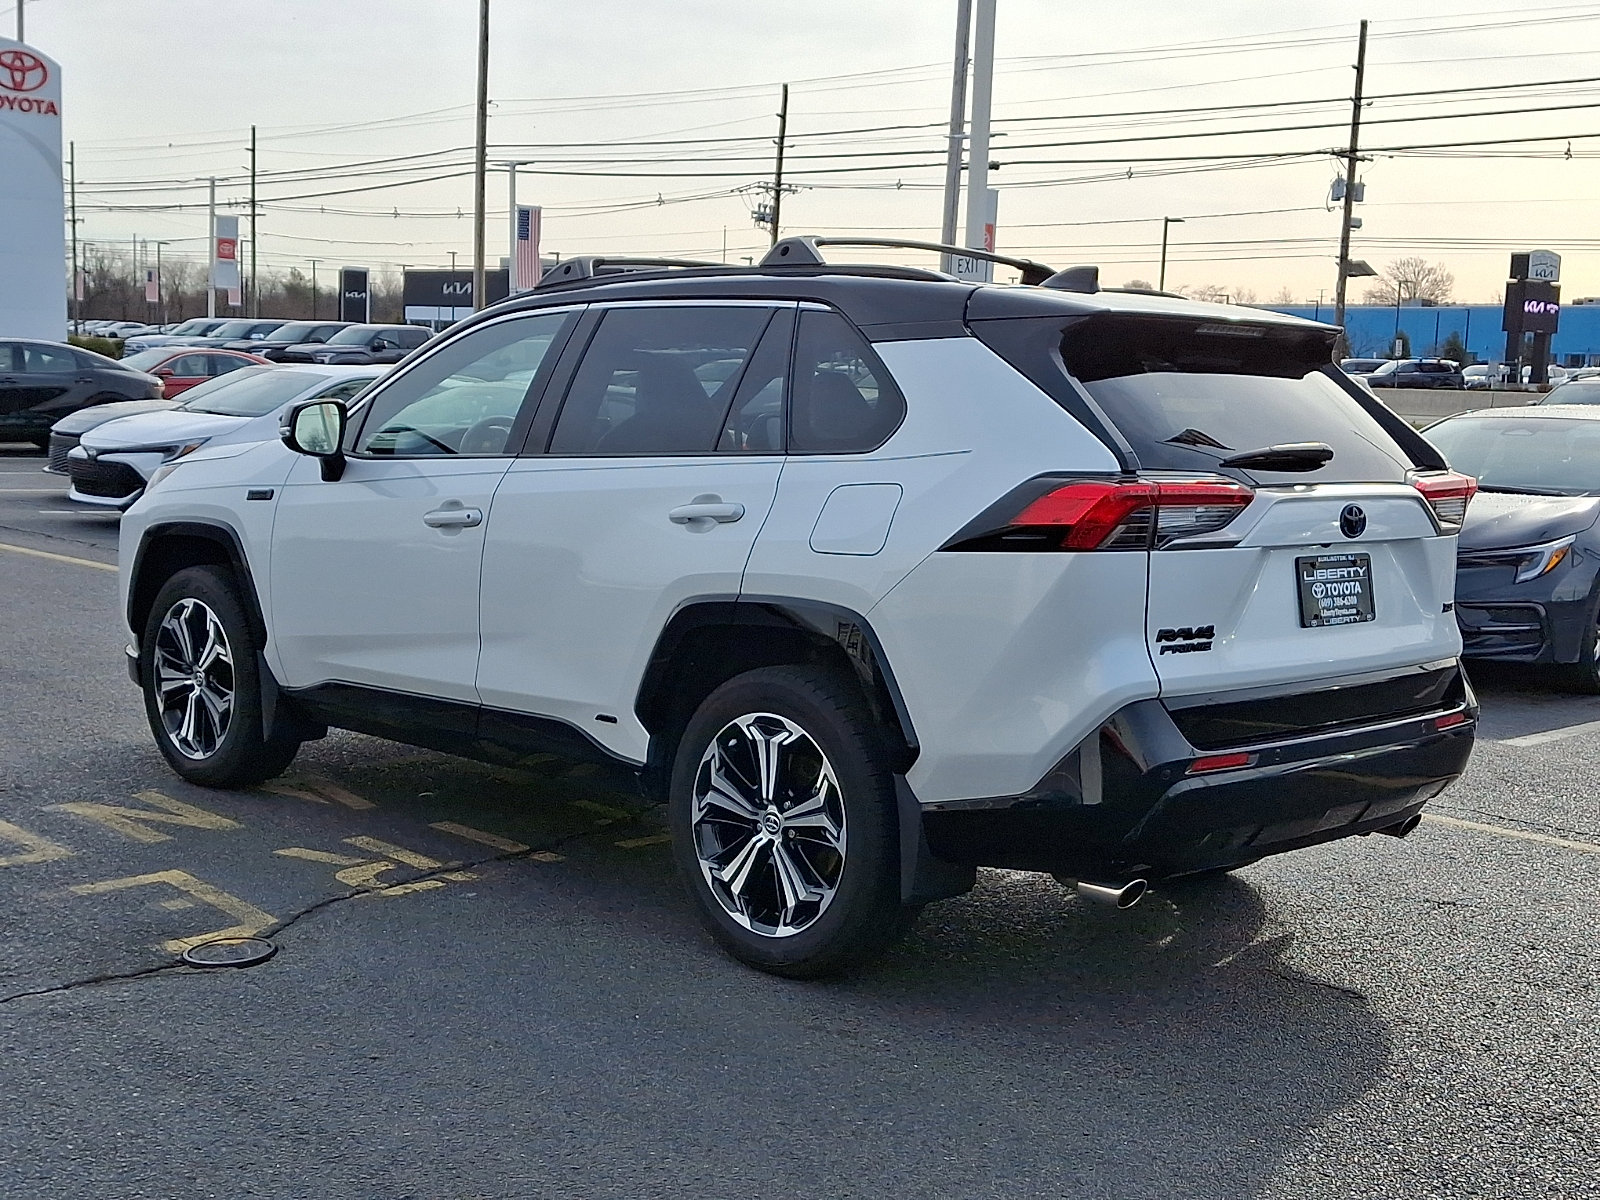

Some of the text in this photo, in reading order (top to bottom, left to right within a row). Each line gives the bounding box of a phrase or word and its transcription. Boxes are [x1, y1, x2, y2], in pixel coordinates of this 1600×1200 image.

[957, 257, 979, 274] EXIT
[1304, 567, 1366, 580] LIBERTY
[1326, 582, 1362, 596] TOYOTA
[1324, 616, 1360, 625] LIBERTY
[1155, 624, 1216, 643] RAV4
[1159, 641, 1213, 656] PRIME
